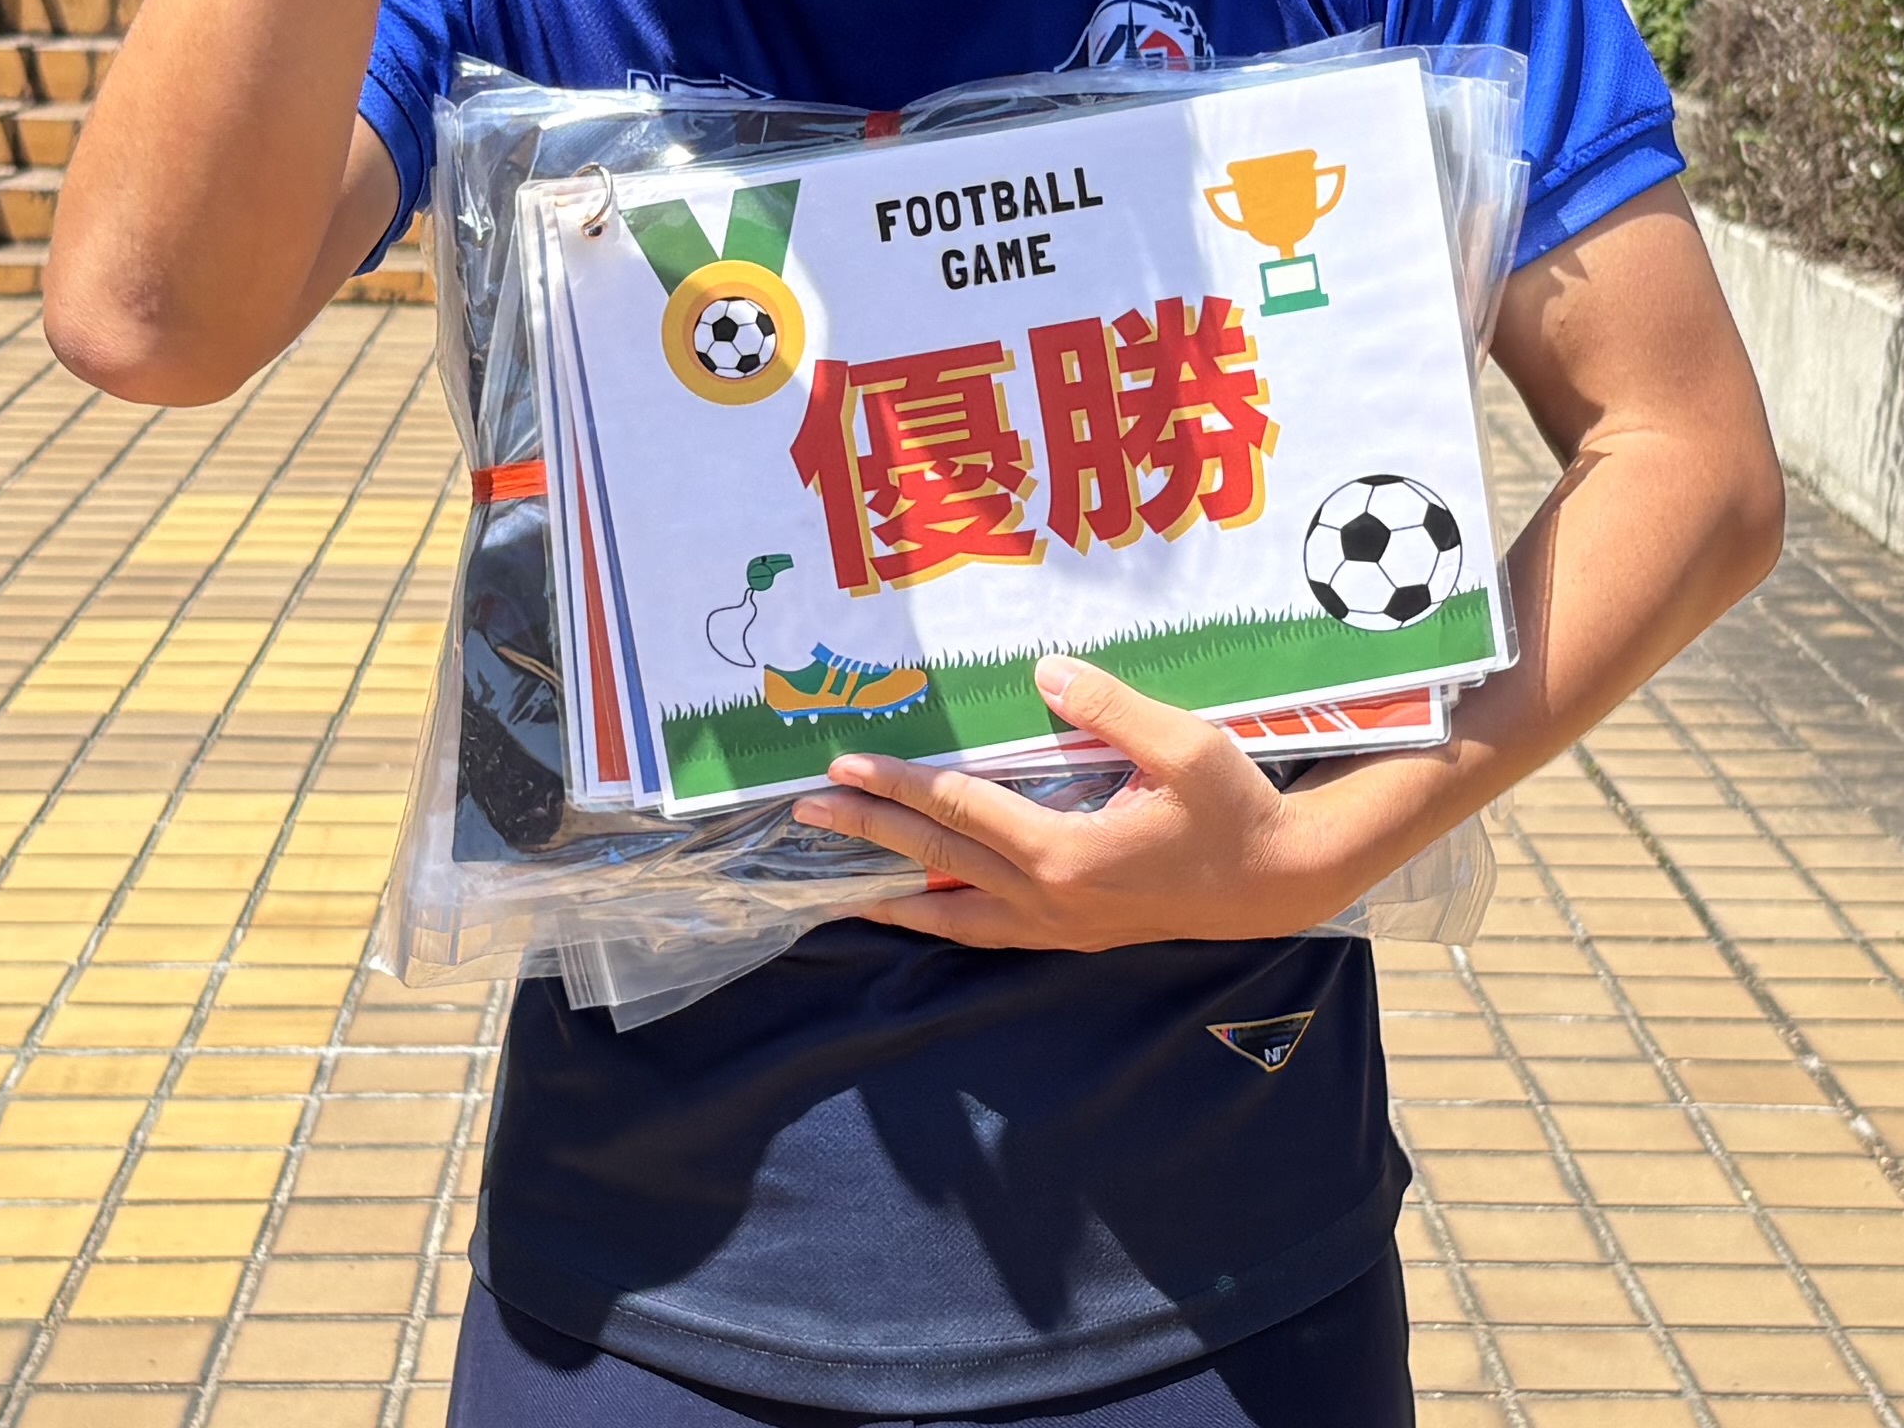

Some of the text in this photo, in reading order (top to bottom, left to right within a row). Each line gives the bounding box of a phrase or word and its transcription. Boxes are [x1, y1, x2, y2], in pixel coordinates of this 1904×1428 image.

[875, 167, 1104, 242] FOOTBALL
[941, 233, 1056, 290] GAME
[790, 295, 1280, 597] 優勝
